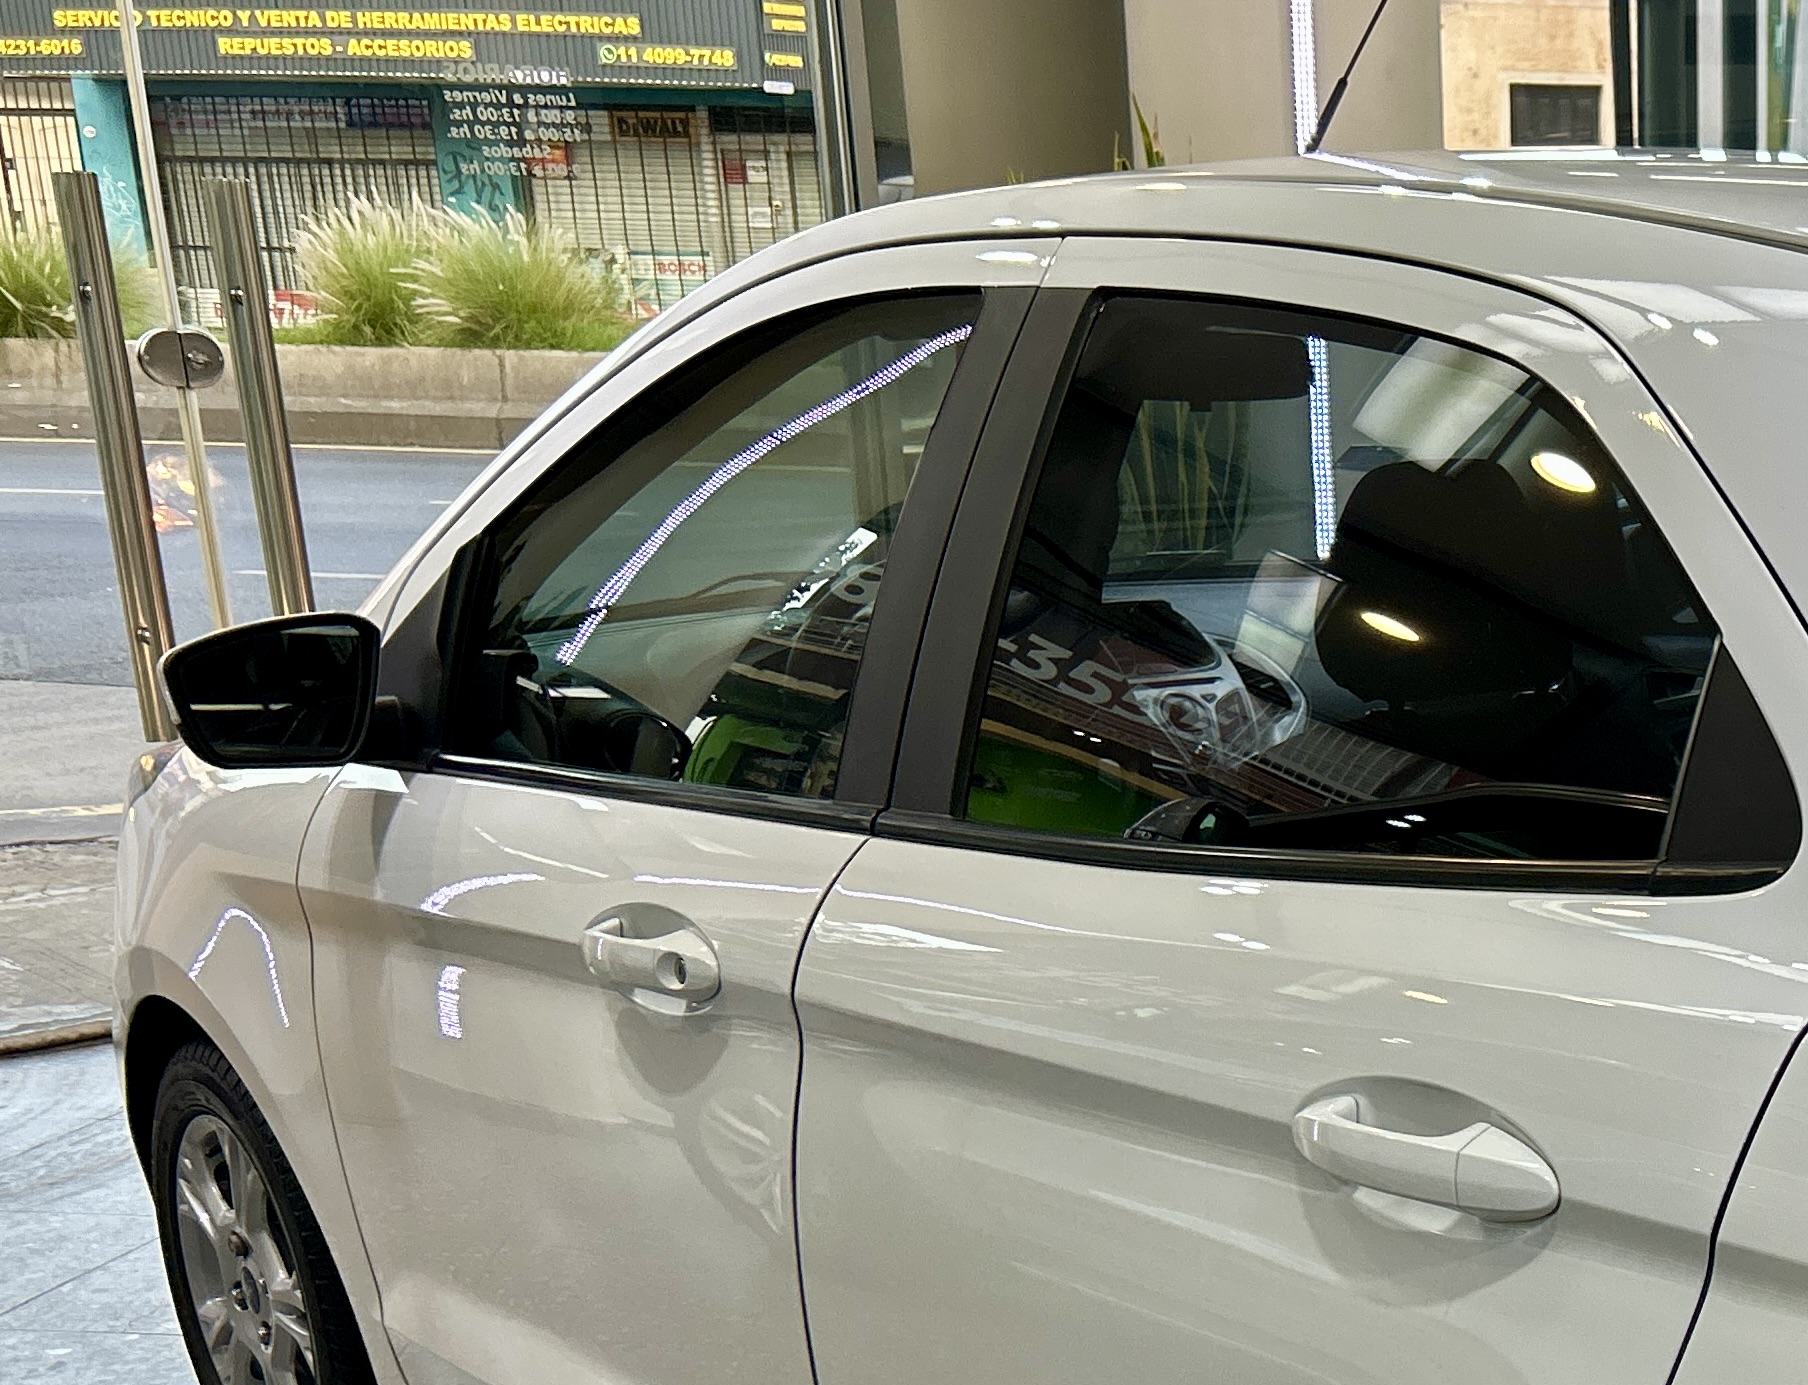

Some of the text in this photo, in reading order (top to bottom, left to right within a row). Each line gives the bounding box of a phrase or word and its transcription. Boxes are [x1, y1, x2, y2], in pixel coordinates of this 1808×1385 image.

[53, 10, 641, 35] SERVICO TECNICO Y VENTA DE HERRAMIENTAS ELECTRICAS
[218, 37, 333, 55] REPUESTOS
[348, 39, 472, 58] ACCESORIOS
[617, 47, 734, 66] 11 4099-7748
